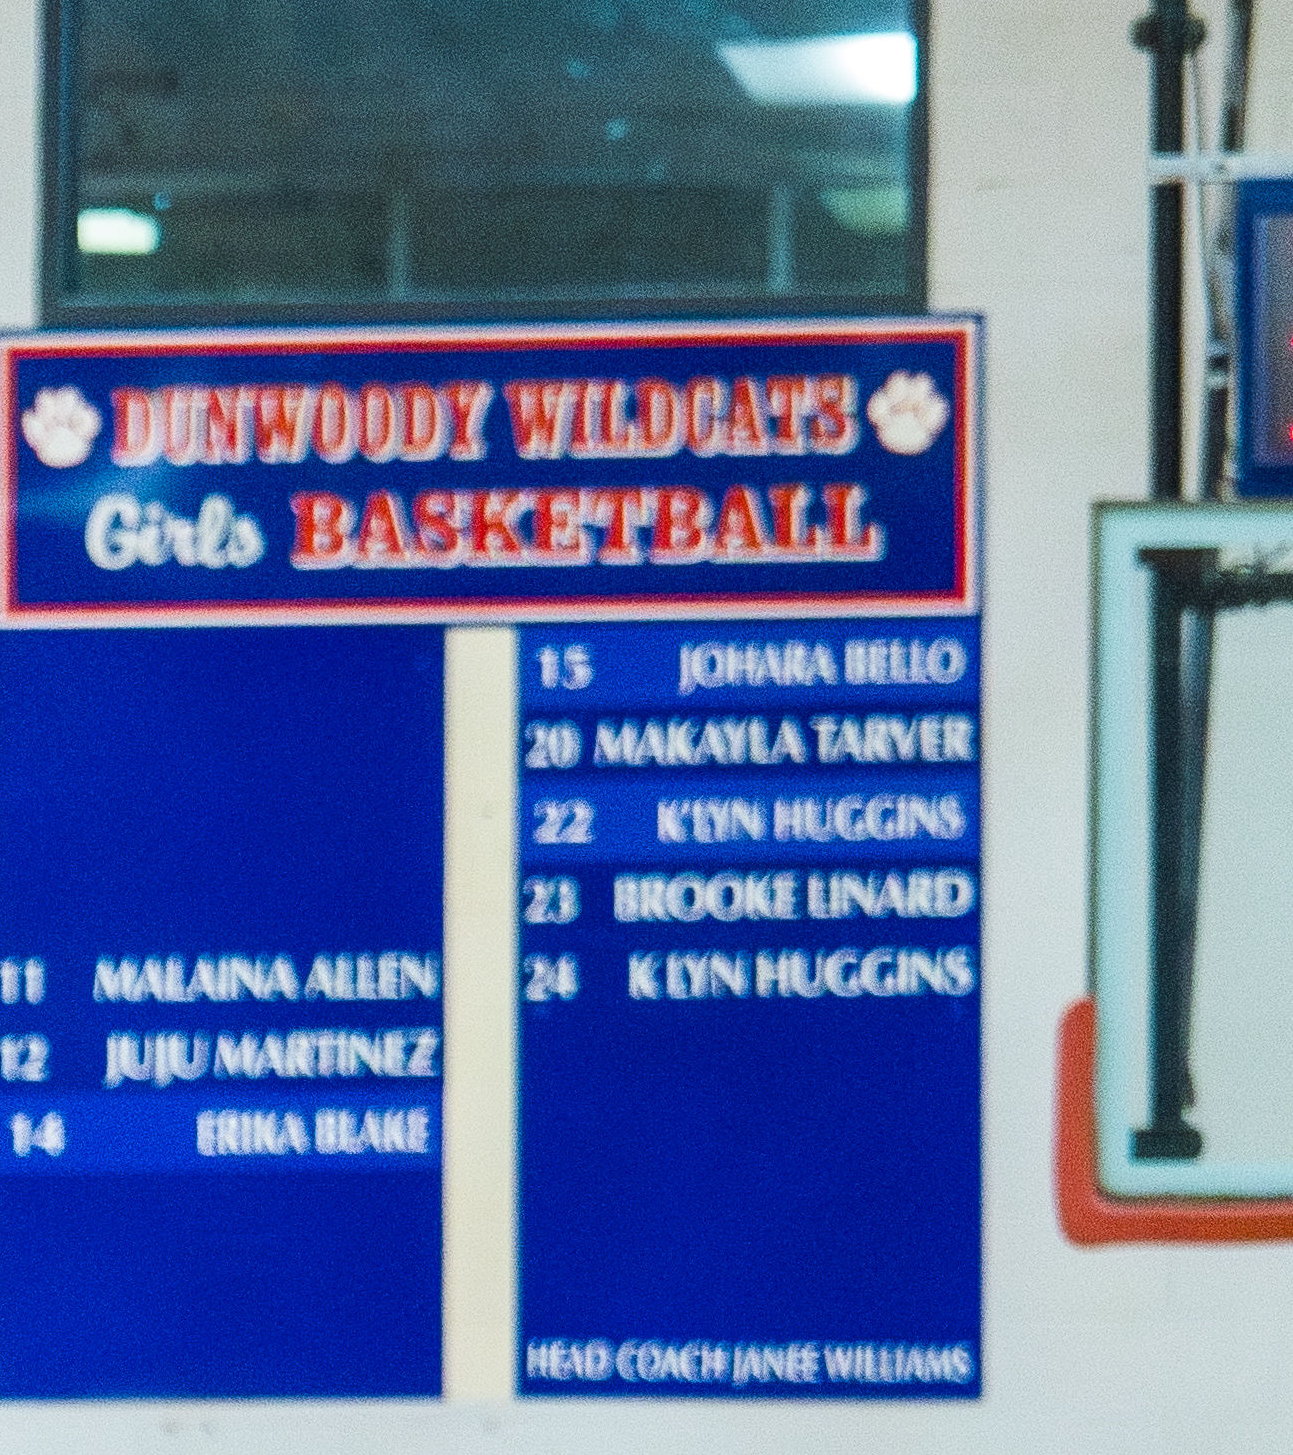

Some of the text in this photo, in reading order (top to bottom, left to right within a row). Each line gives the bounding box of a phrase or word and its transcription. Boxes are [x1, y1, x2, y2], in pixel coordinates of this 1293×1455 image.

[110, 372, 858, 467] DUNWOODY WILDCATS
[85, 483, 885, 570] Girls BASKETBALL
[540, 646, 591, 689] 15
[525, 725, 581, 769] 20
[593, 719, 806, 766] MAKAYLA
[533, 800, 594, 845] 22
[772, 794, 966, 842] HUGGINS
[524, 879, 577, 924] 23
[612, 872, 796, 922] BROOKE
[92, 956, 299, 1003] MALAINA
[304, 952, 438, 1001] ALLEN
[525, 956, 578, 1003] 24
[754, 950, 974, 998] HUGGINS
[0, 1029, 439, 1086] 12 JUJU MARTINEZ
[526, 1339, 614, 1380] HEAD
[616, 1339, 729, 1381] COACH
[825, 1343, 974, 1384] WILLIAMS
